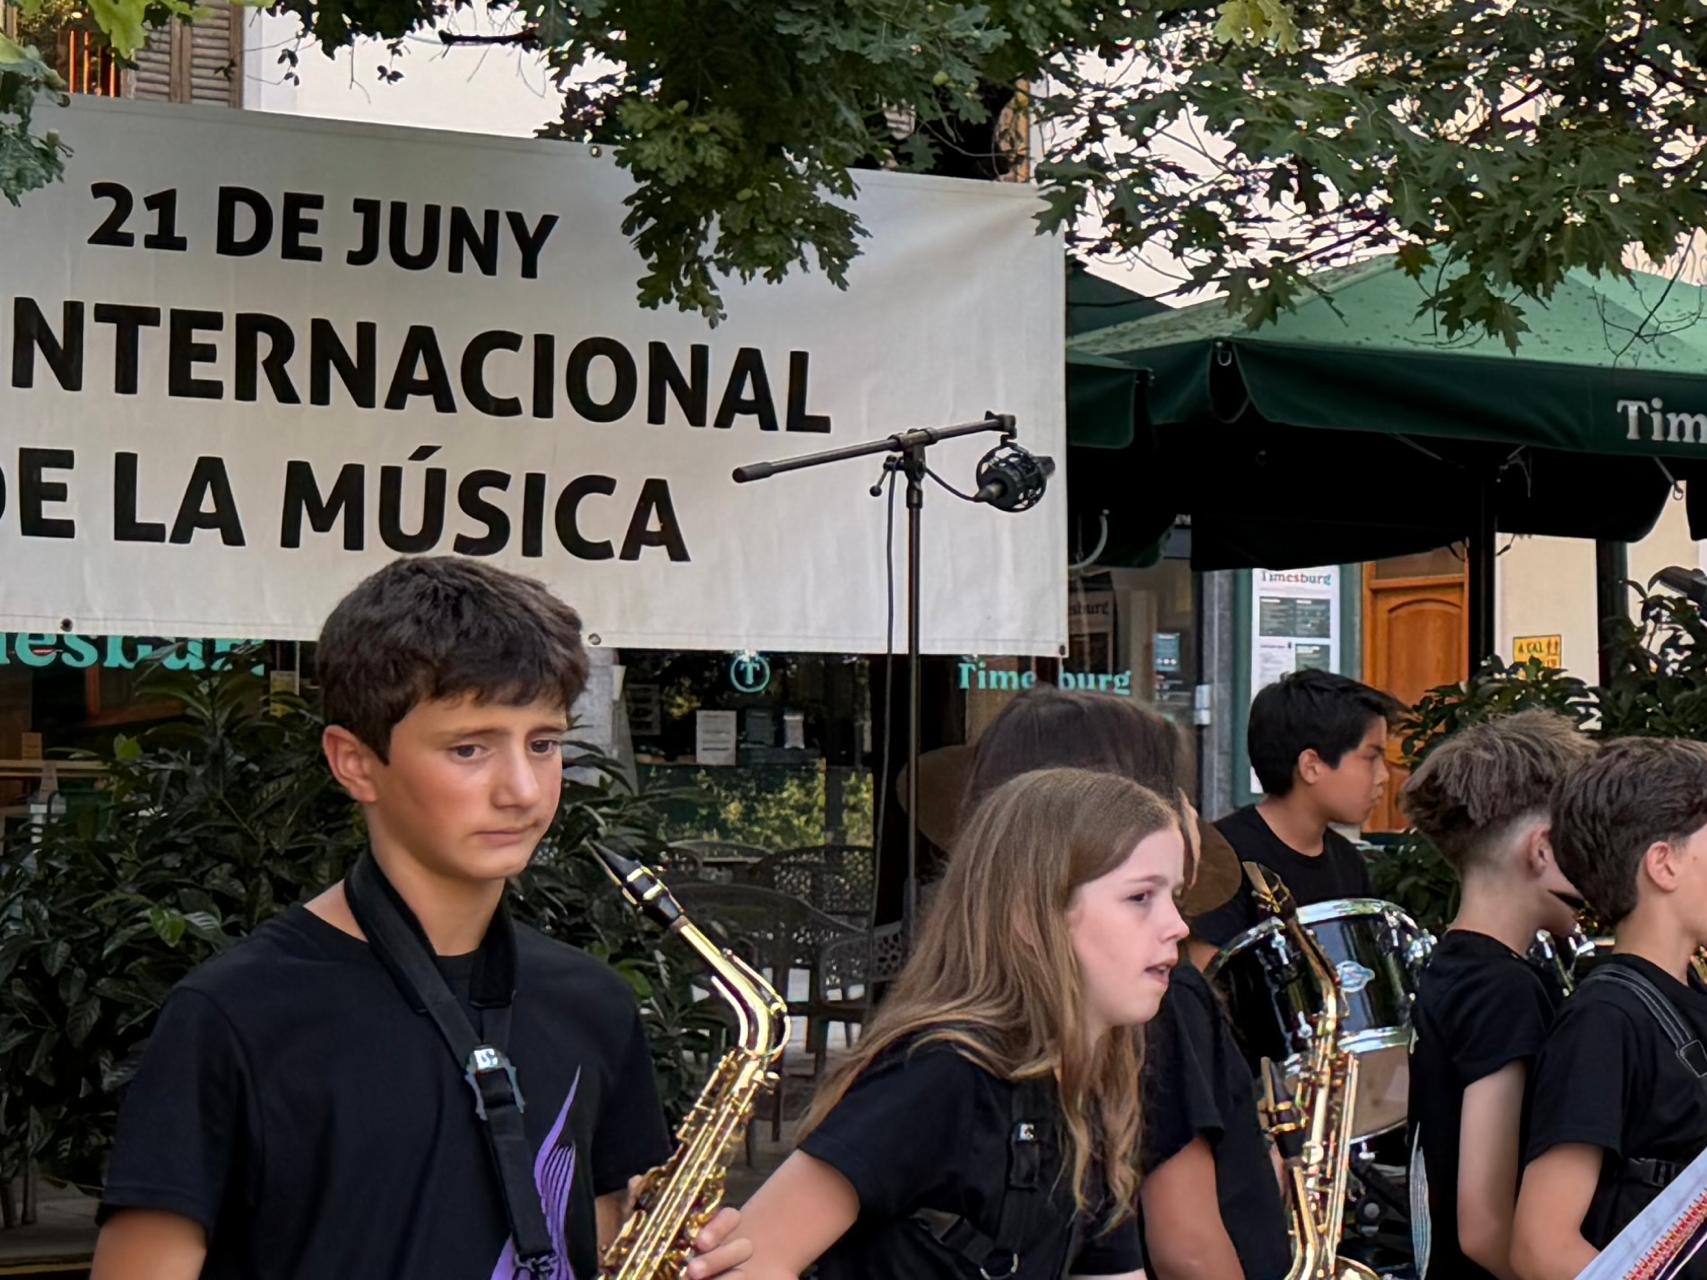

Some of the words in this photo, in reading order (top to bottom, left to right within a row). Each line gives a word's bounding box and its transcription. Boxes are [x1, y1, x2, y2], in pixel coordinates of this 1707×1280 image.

[88, 181, 188, 252] 21
[216, 186, 324, 263] DE
[346, 197, 559, 280] JUNY
[11, 296, 832, 434] NTERNACIONAL
[0, 447, 76, 540] E
[113, 451, 246, 547] LA
[280, 445, 692, 562] MÚSICA
[957, 660, 1133, 697] Timeburg
